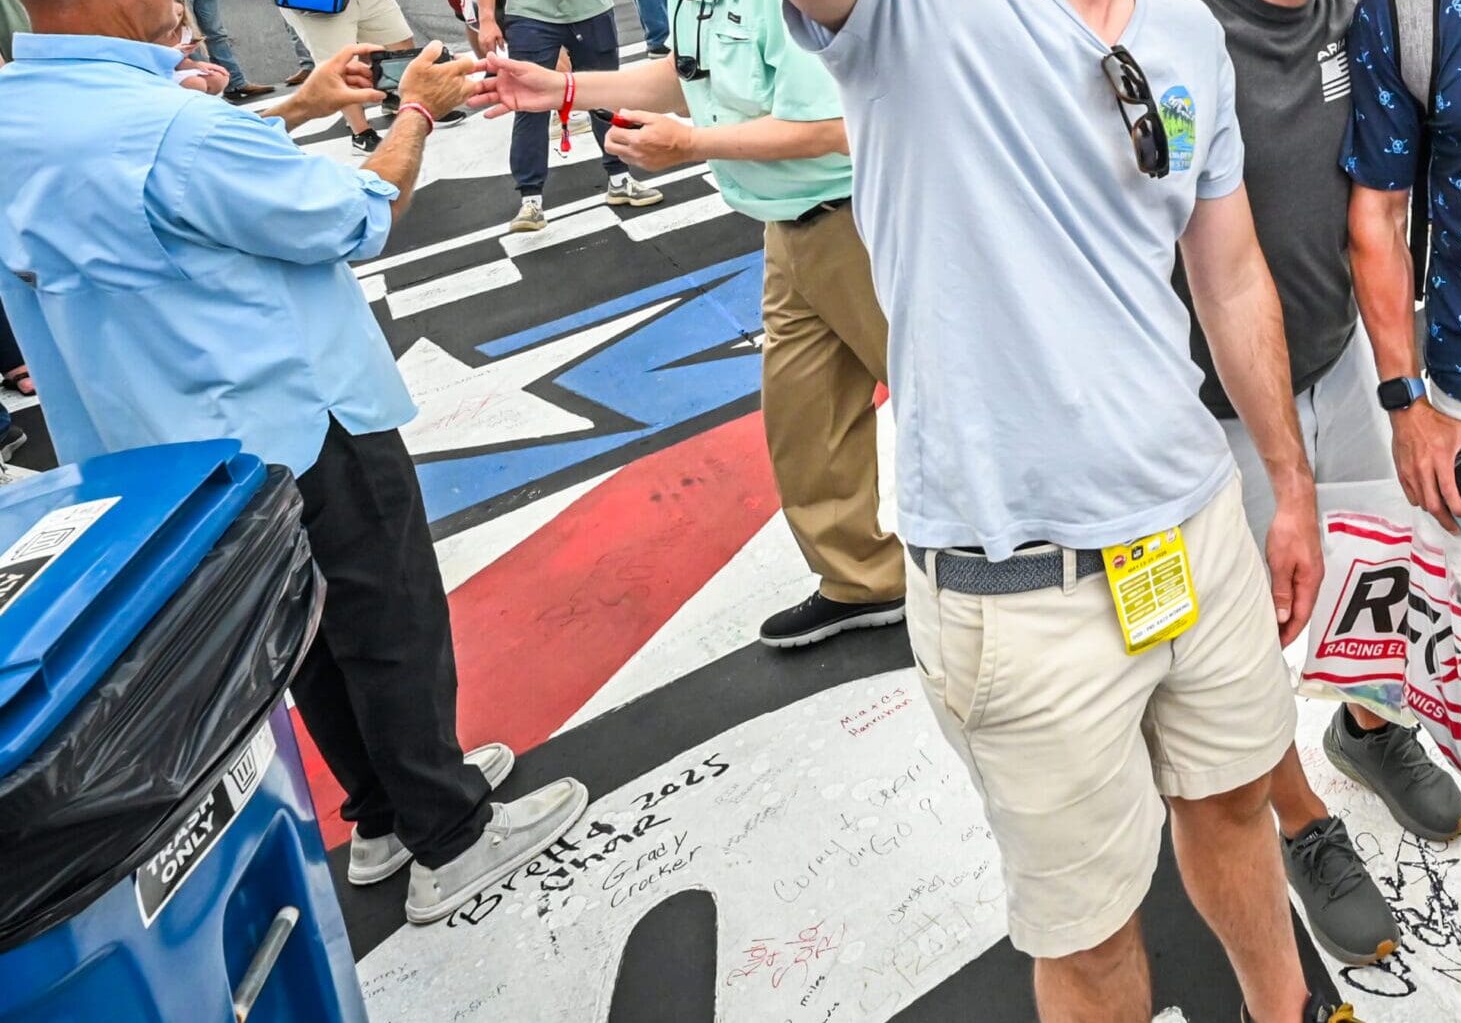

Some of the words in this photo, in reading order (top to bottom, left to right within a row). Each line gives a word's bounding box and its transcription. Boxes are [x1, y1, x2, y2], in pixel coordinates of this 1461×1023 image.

[1317, 38, 1346, 62] ARIA
[1324, 641, 1384, 657] RACING
[630, 752, 731, 810] 2025
[161, 810, 215, 884] ONLY
[602, 831, 689, 892] Grady
[609, 845, 702, 910] Crocker
